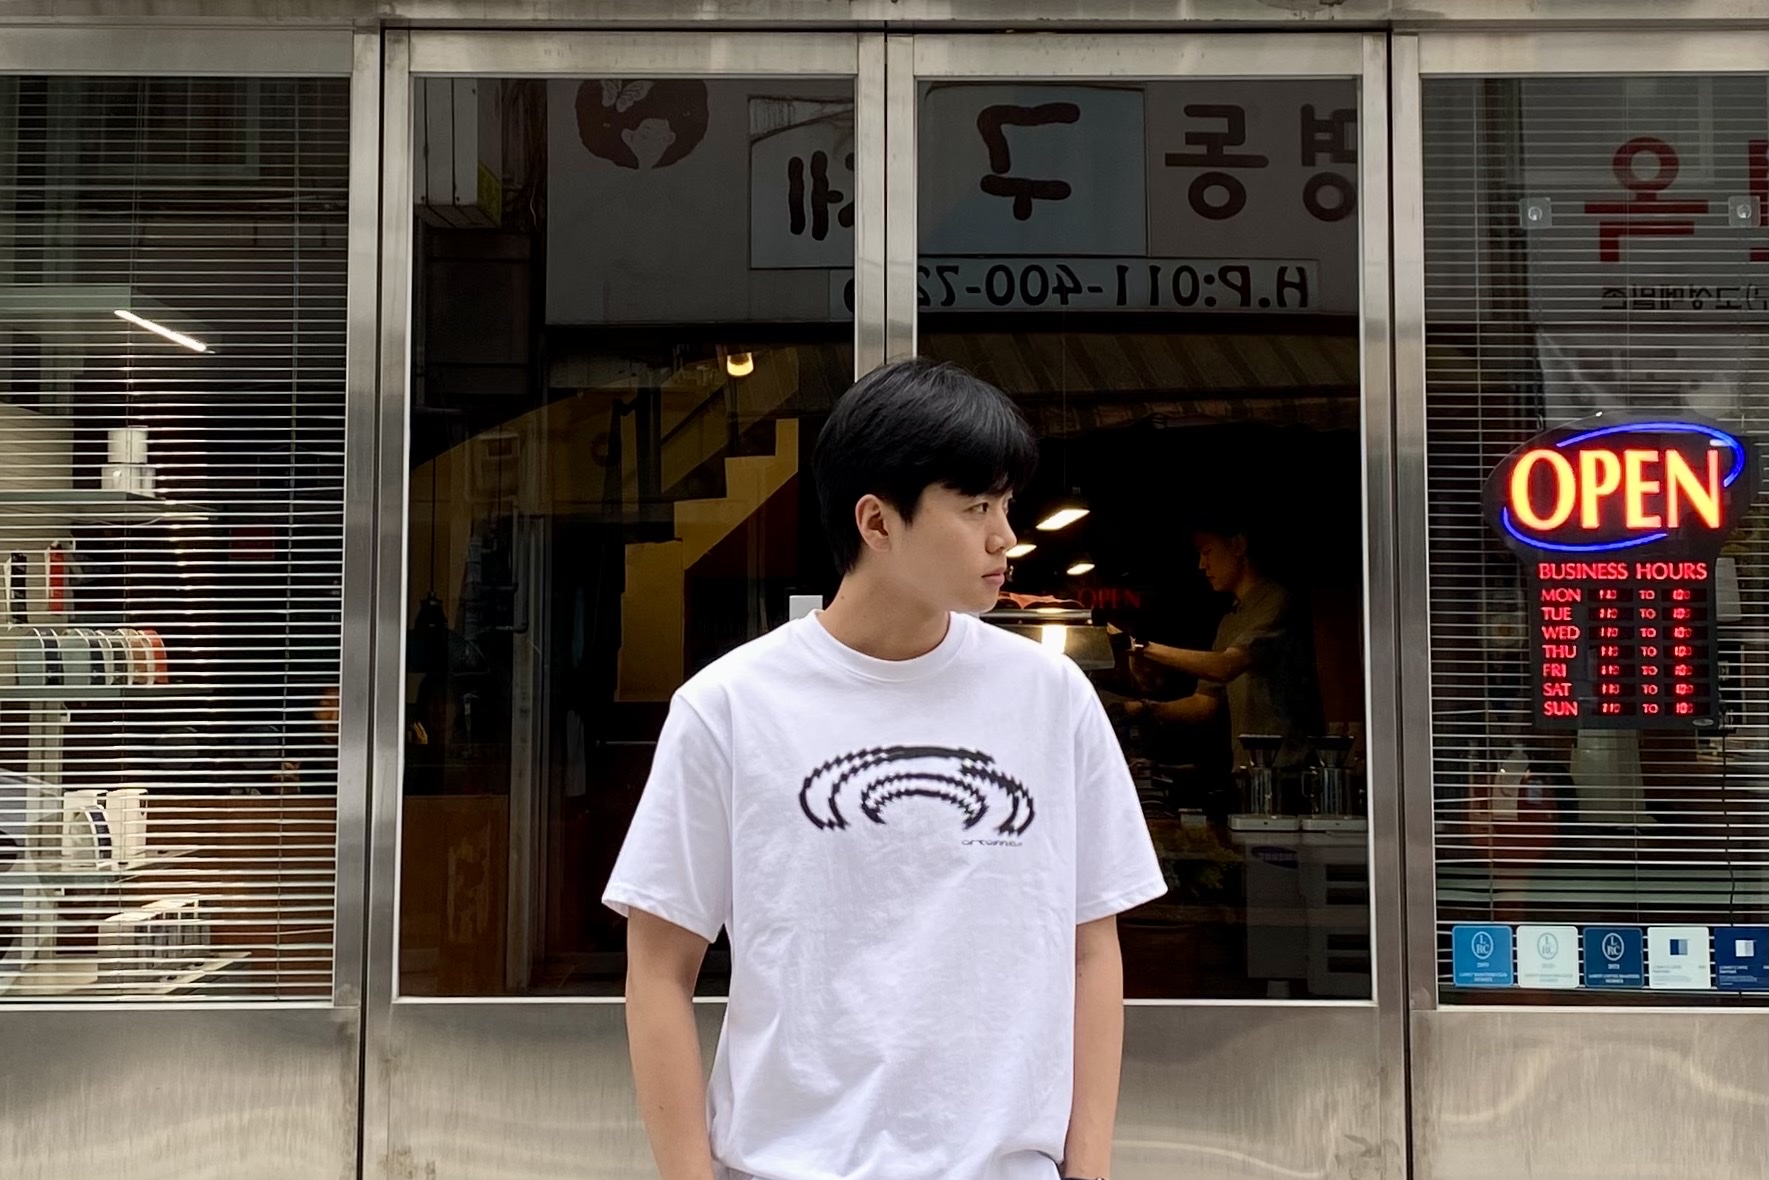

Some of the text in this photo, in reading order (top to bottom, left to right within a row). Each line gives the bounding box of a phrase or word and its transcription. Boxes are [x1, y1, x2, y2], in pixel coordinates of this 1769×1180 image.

[1510, 448, 1720, 531] OPEN
[1538, 562, 1708, 580] BUSINESS HOURS
[1541, 587, 1656, 602] MON TO
[1541, 606, 1573, 621] TUE
[1639, 608, 1657, 619] TO
[1541, 625, 1657, 640] WED TO
[1542, 644, 1577, 659] THU
[1640, 646, 1658, 657] TO
[1542, 663, 1659, 677] FRI TO
[1542, 682, 1573, 697] SAT
[1641, 684, 1659, 695] TO
[1543, 701, 1659, 716] SUN TO
